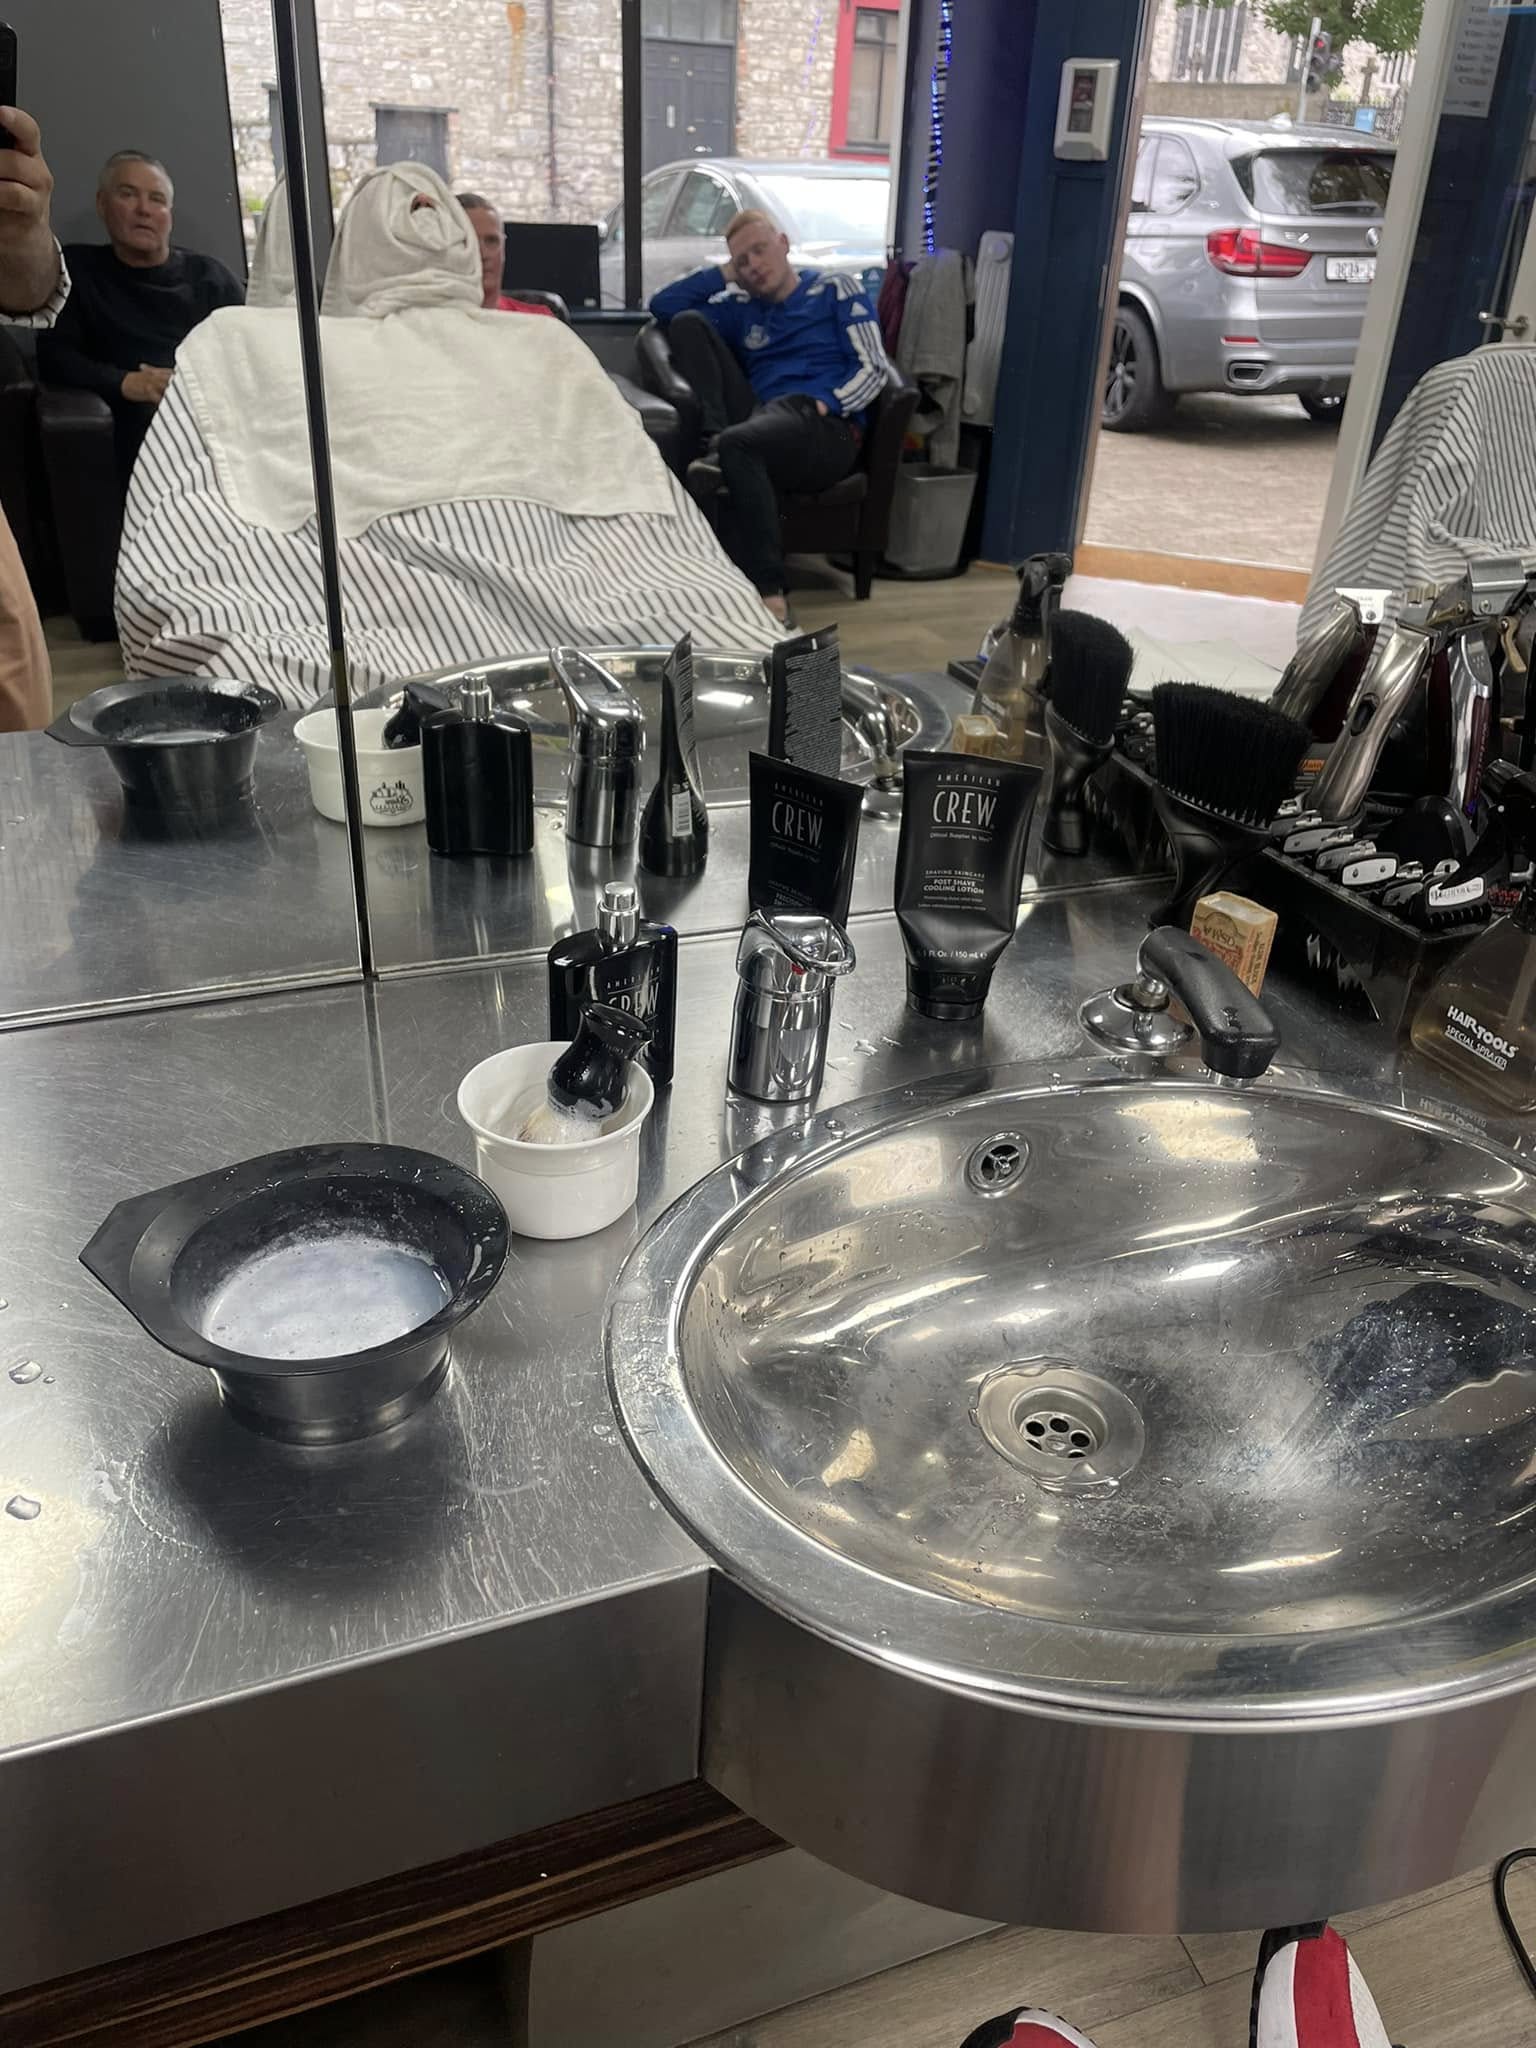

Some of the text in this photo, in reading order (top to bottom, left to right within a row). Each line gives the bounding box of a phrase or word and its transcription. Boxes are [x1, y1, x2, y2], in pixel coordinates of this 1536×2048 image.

[772, 801, 822, 846] CREW
[932, 790, 997, 827] CREW
[953, 879, 976, 887] SHAVE
[957, 887, 984, 895] LOTION
[1445, 1024, 1508, 1069] SPECIAL SPRAYER
